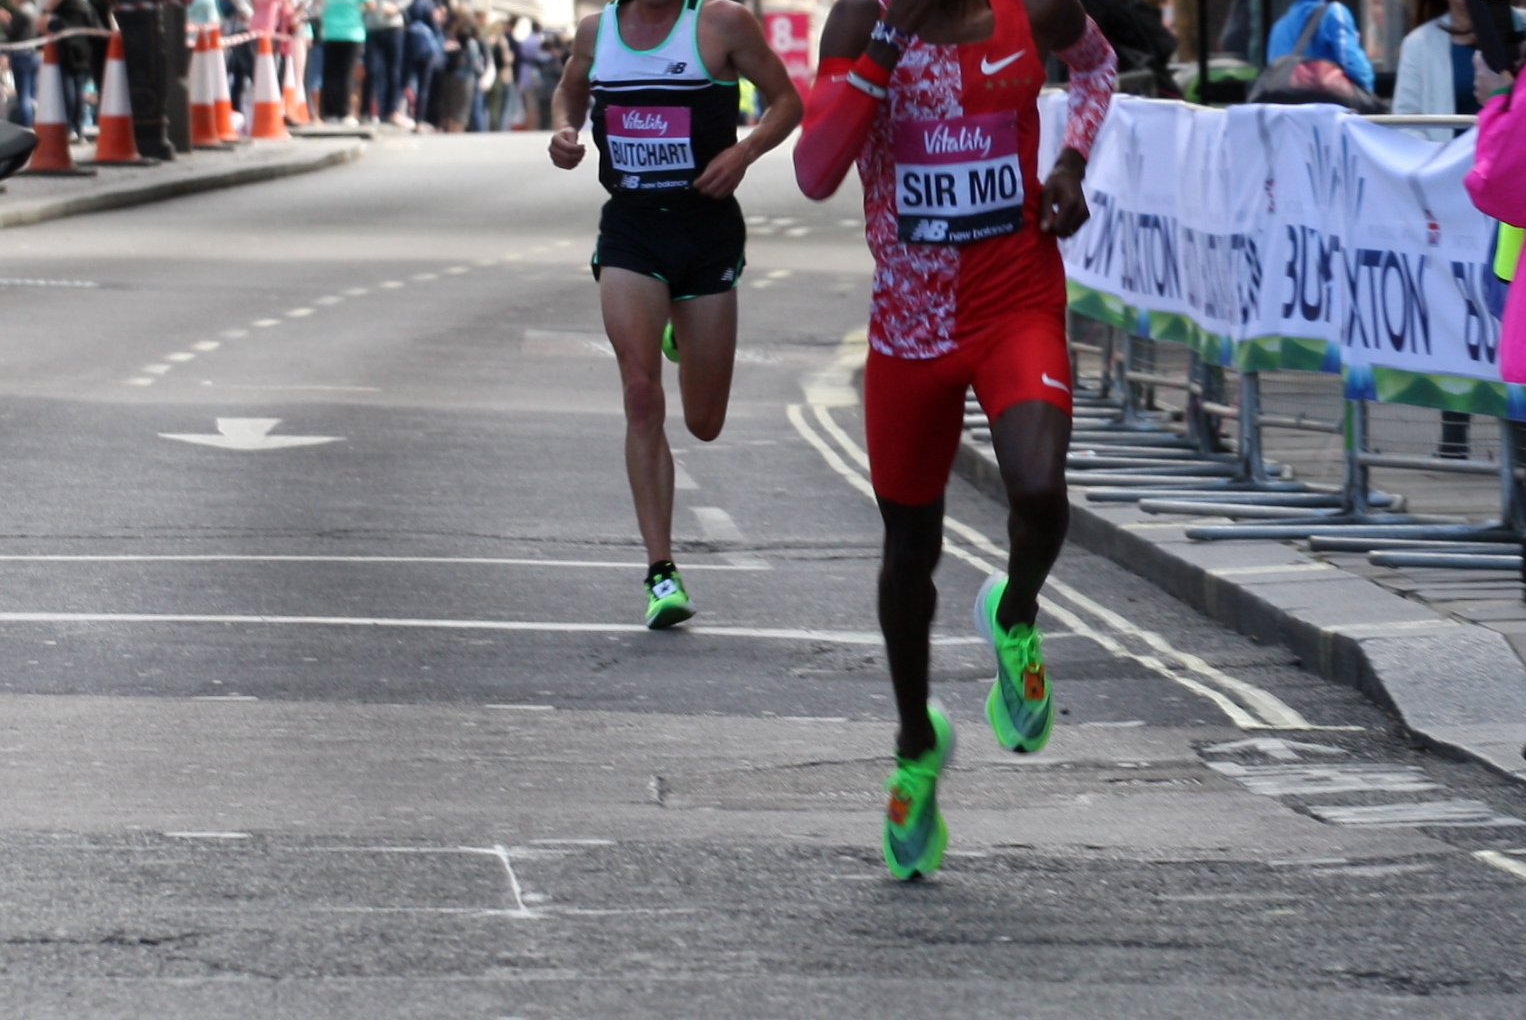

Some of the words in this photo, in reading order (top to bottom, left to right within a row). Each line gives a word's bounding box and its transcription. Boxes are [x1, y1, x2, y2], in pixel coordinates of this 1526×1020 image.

[771, 16, 793, 52] 8
[622, 109, 668, 136] Vitality
[610, 141, 688, 167] BUTCHART
[924, 123, 992, 158] Vitality
[903, 171, 957, 207] SIR
[969, 164, 1017, 205] MO
[949, 229, 972, 241] new
[973, 222, 1014, 238] balance
